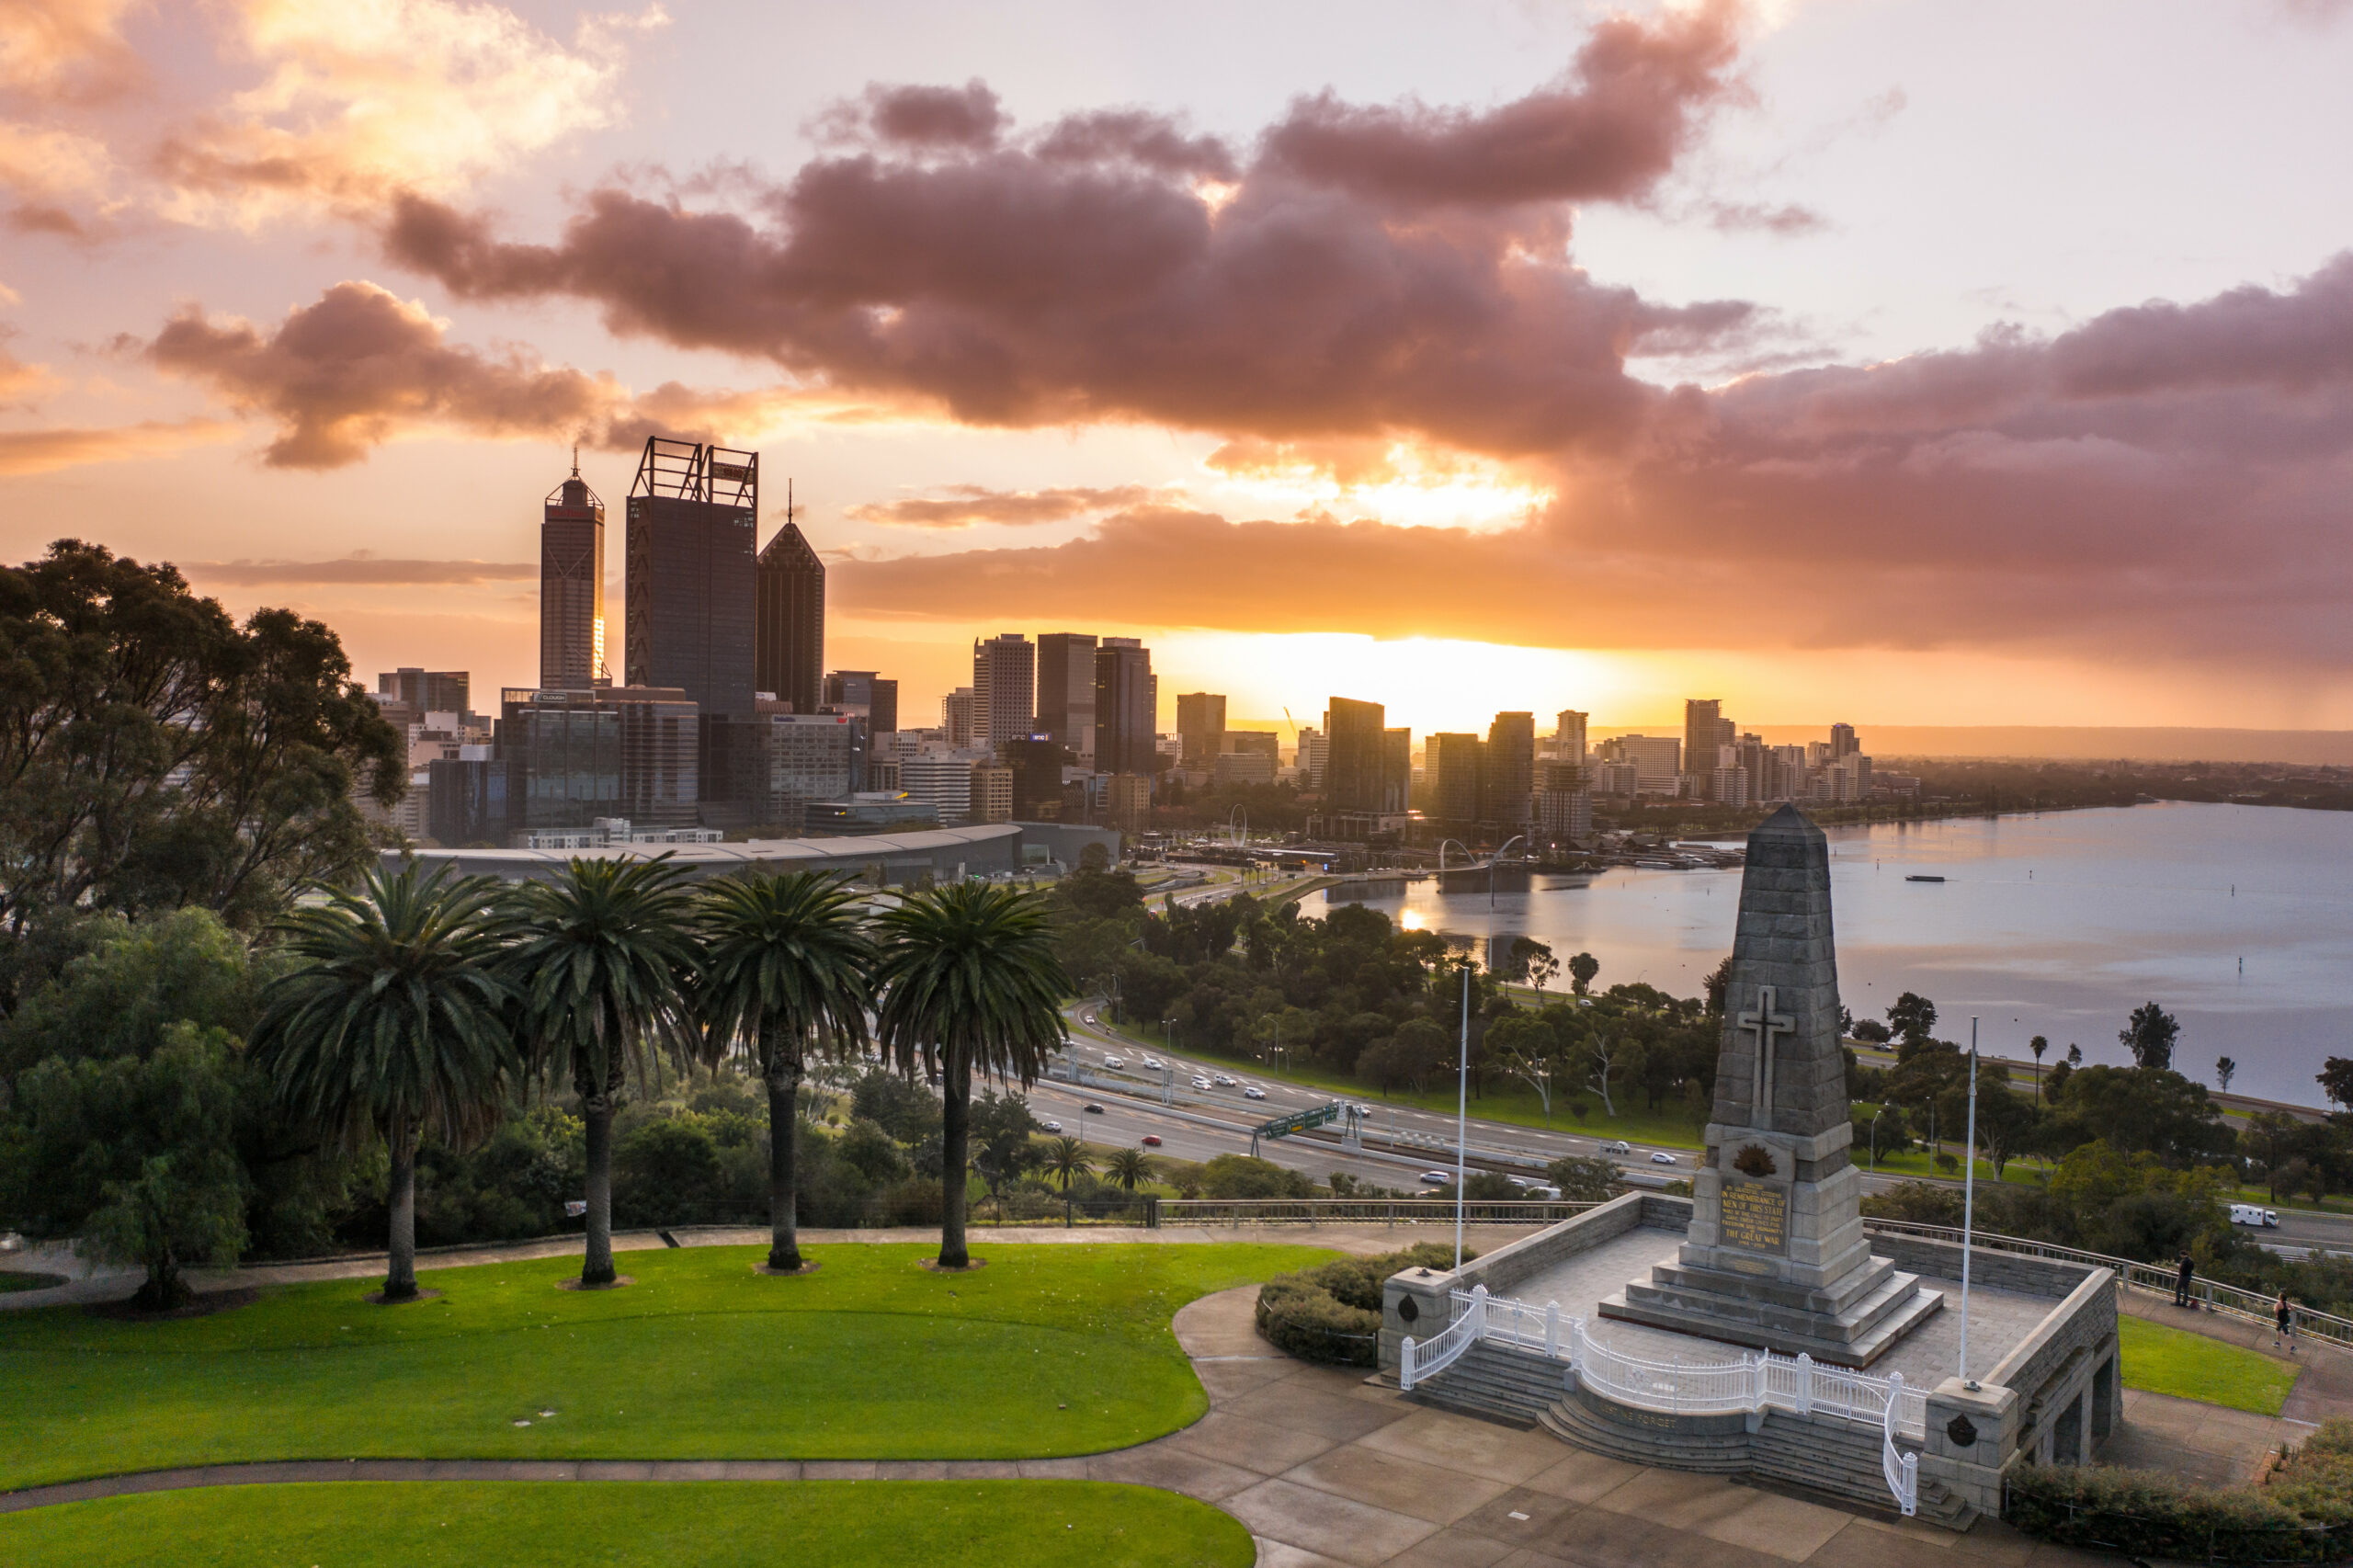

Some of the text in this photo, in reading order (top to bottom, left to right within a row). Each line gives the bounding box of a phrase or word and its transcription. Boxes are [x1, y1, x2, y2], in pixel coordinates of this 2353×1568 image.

[1729, 1192, 1775, 1205] REMEMBRANCE
[1722, 1199, 1736, 1208] MEN
[1750, 1204, 1763, 1213] THIS
[1765, 1206, 1783, 1216] STATE
[1726, 1229, 1738, 1238] THE
[1741, 1232, 1762, 1242] GREAT
[1765, 1235, 1779, 1245] WAR
[1637, 1414, 1677, 1428] FORGET
